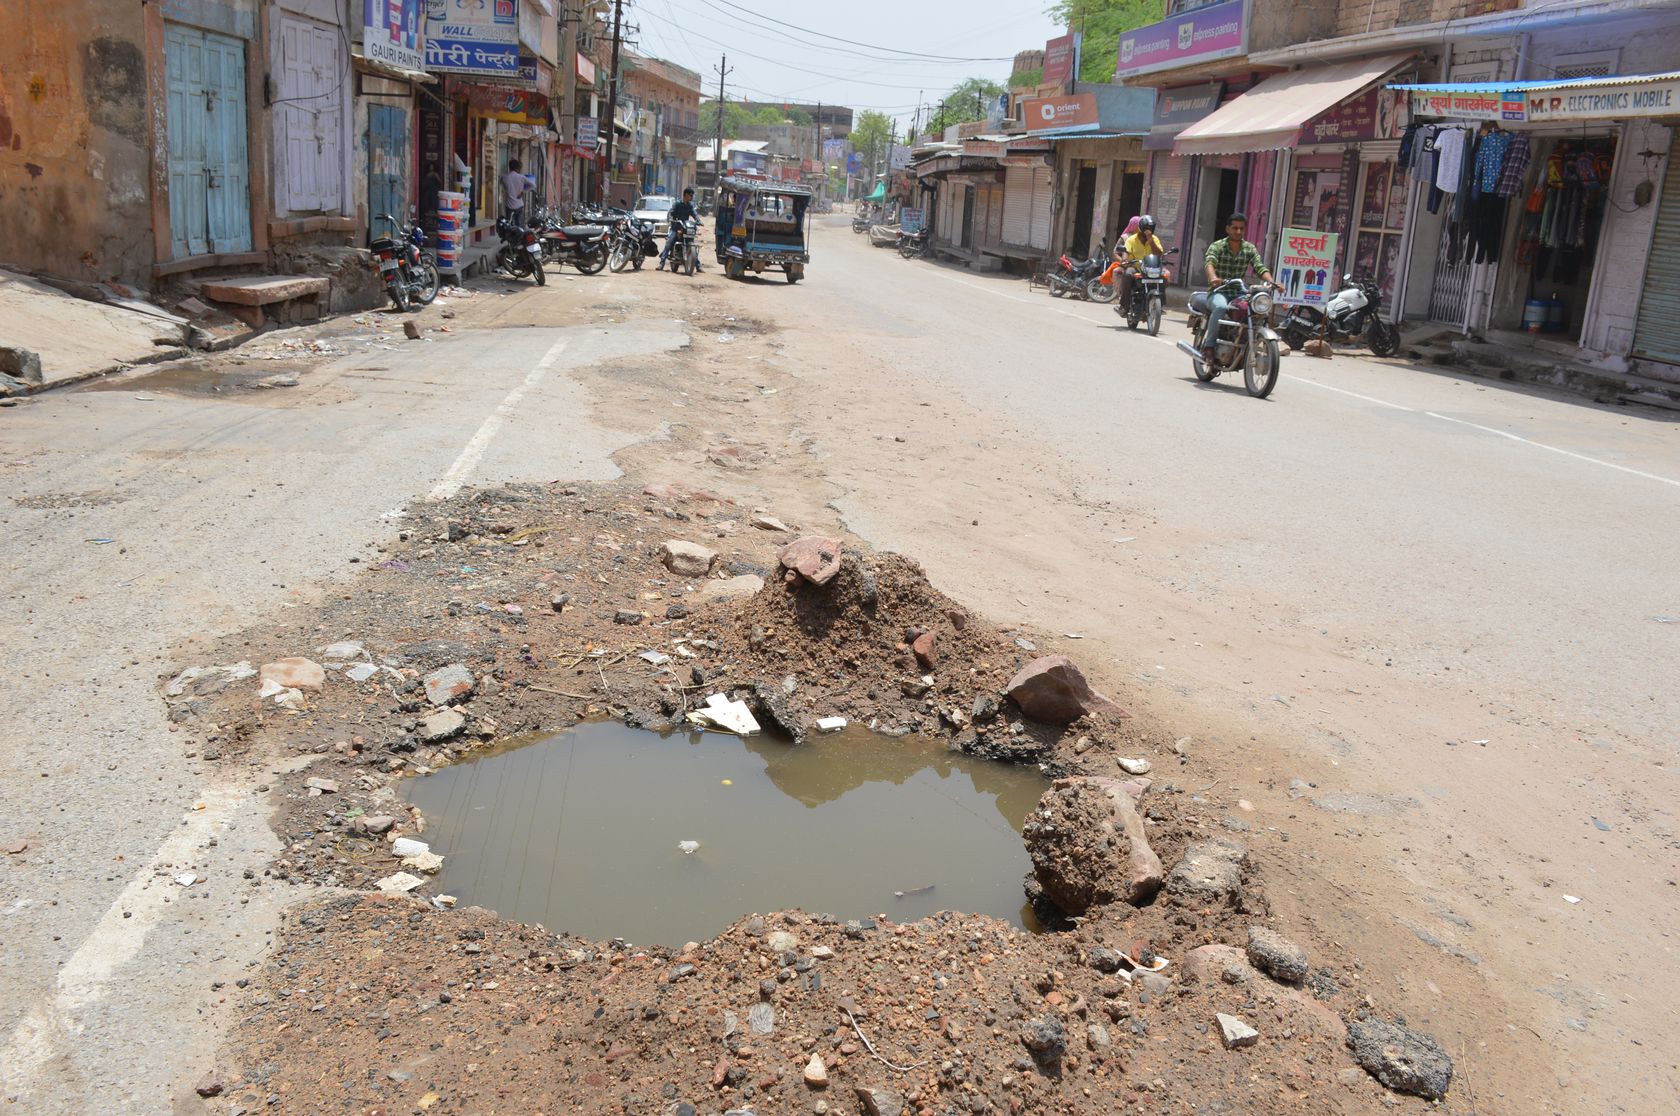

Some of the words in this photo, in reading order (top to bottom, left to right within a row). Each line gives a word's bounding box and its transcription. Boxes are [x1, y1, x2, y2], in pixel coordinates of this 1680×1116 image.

[442, 25, 473, 36] WALL
[1194, 26, 1215, 41] express
[1214, 22, 1238, 38] painting
[371, 43, 397, 62] GAURI
[398, 51, 422, 69] PAINTS
[1057, 103, 1080, 112] orient
[1568, 92, 1629, 112] ELECTRONICS
[1632, 89, 1672, 108] MOBILE
[1288, 234, 1329, 256] सूर्या
[1283, 255, 1330, 269] गारमेन्ट
